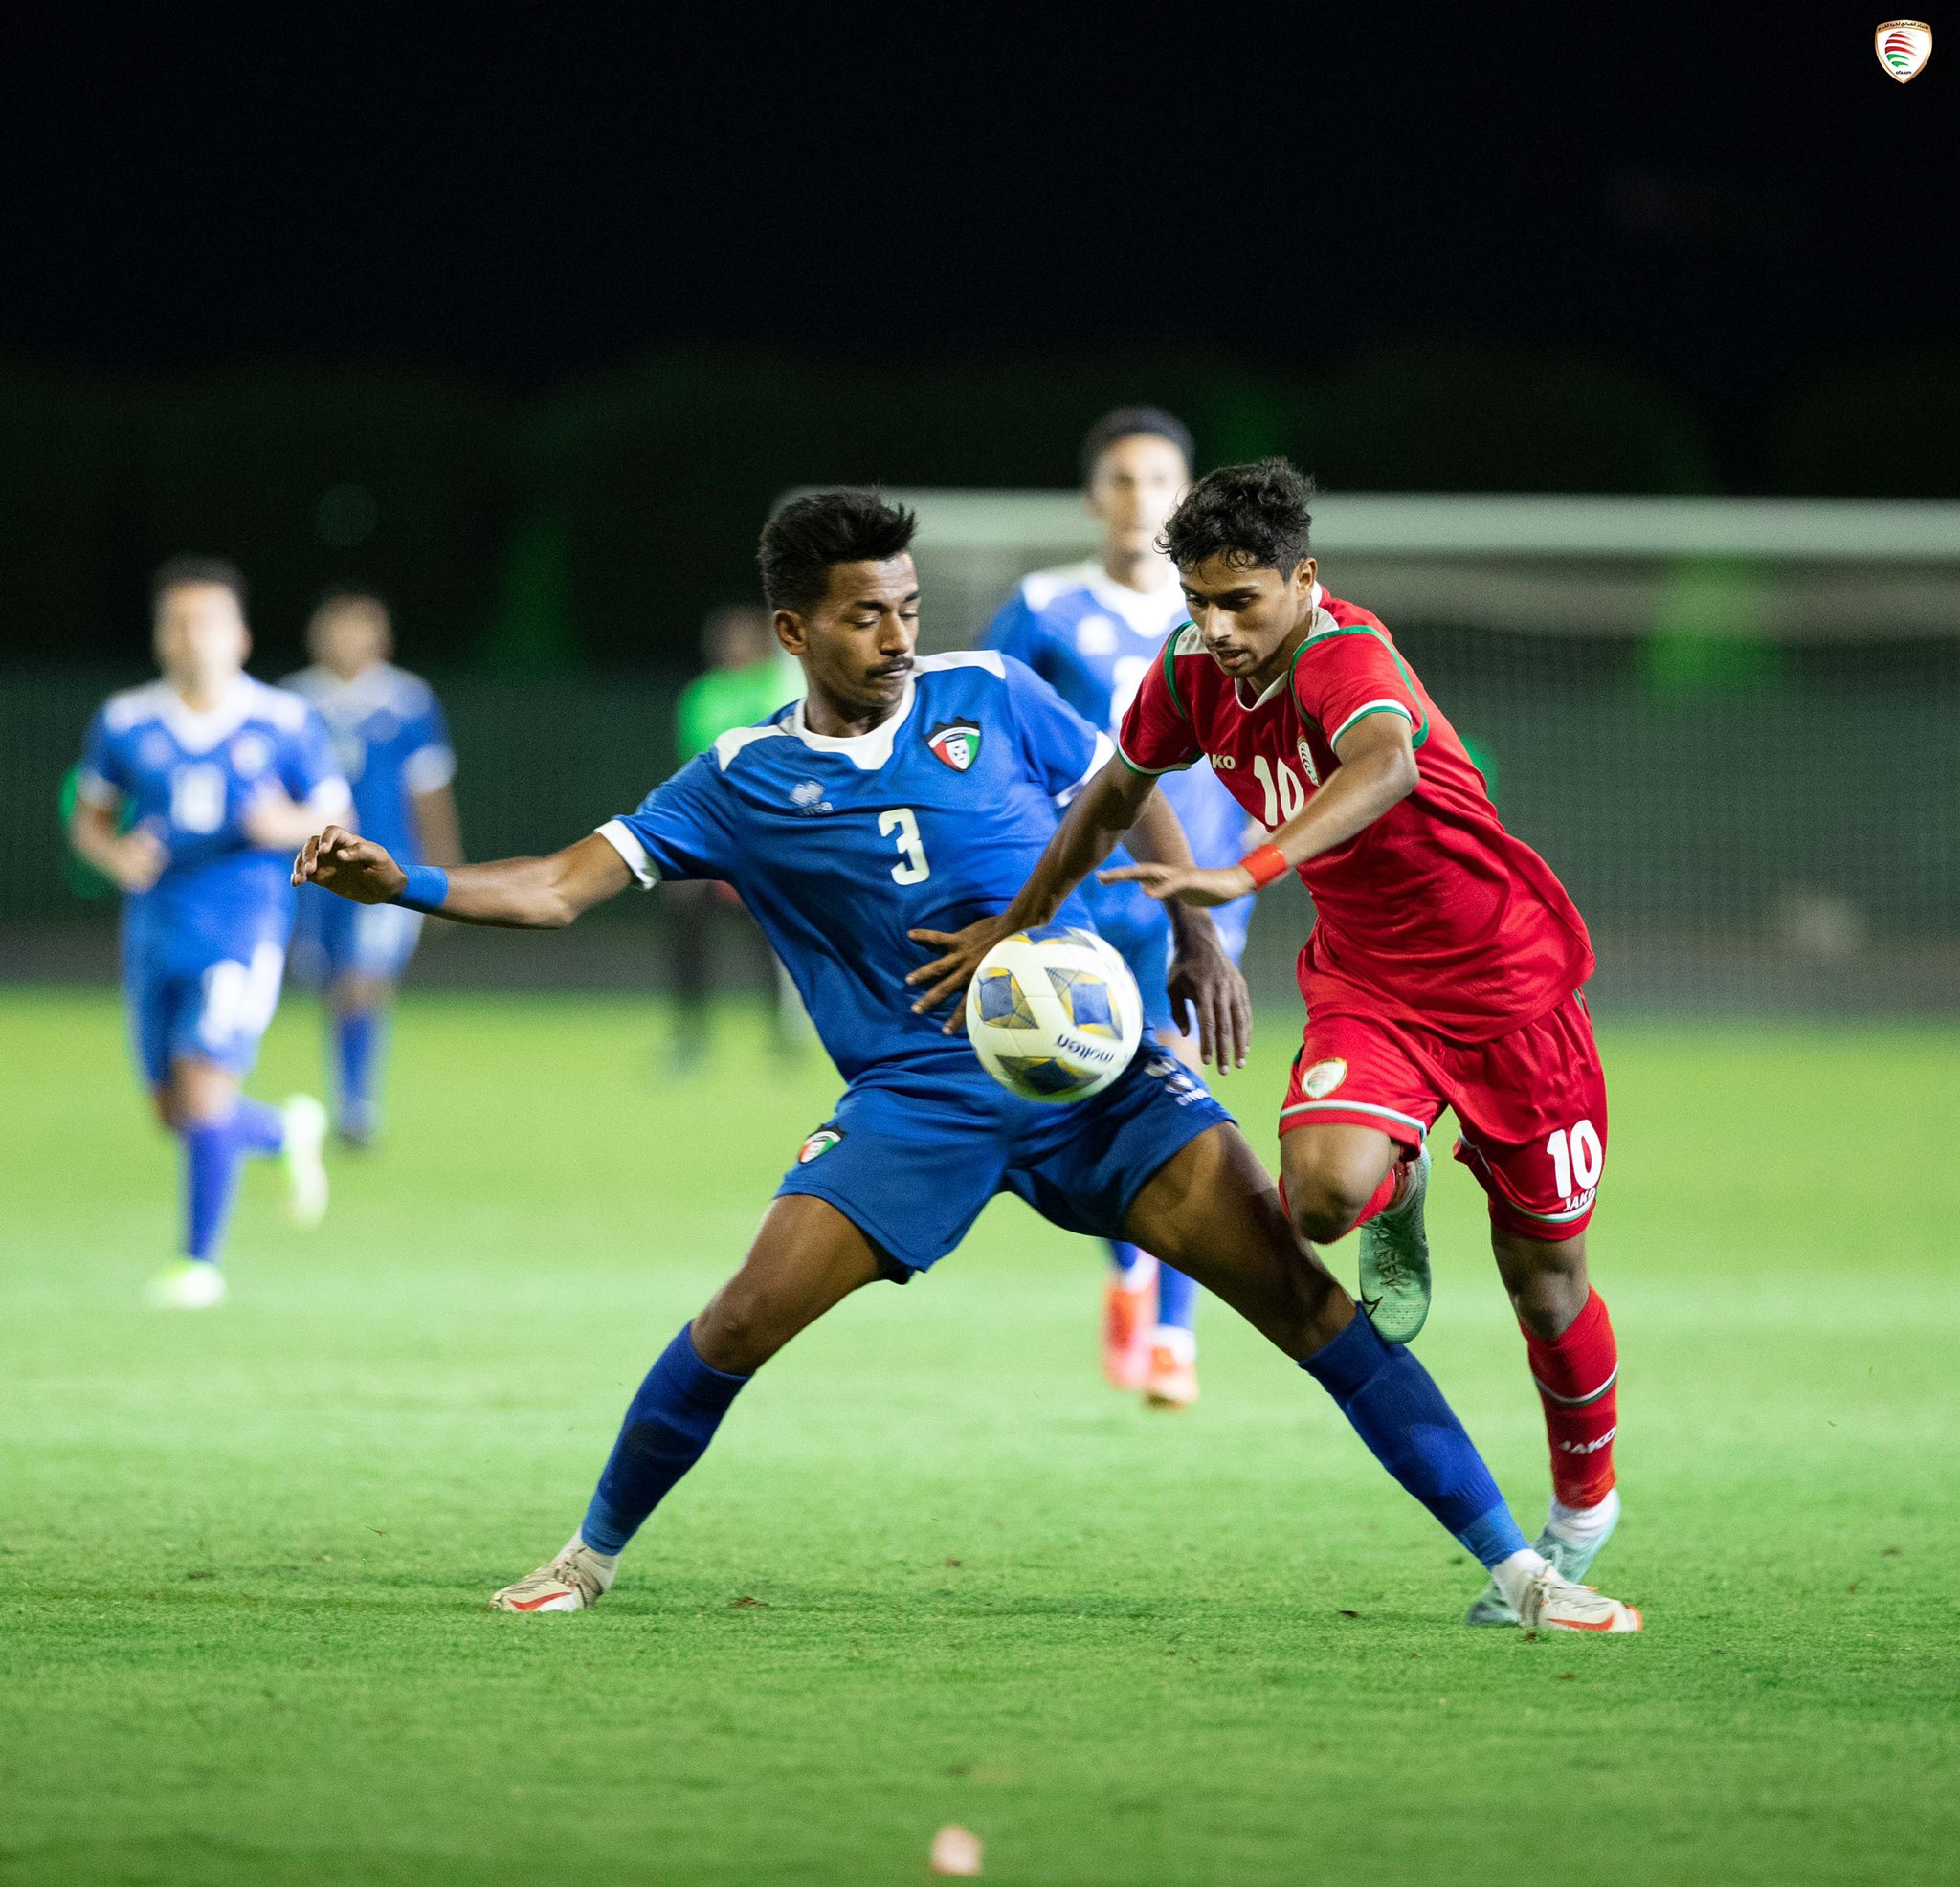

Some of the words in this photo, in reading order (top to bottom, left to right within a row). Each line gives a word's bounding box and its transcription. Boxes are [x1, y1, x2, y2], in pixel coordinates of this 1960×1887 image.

[1254, 755, 1304, 826] 10
[878, 808, 930, 885] 3
[1056, 1034, 1115, 1064] molten
[1546, 1119, 1603, 1199] 10
